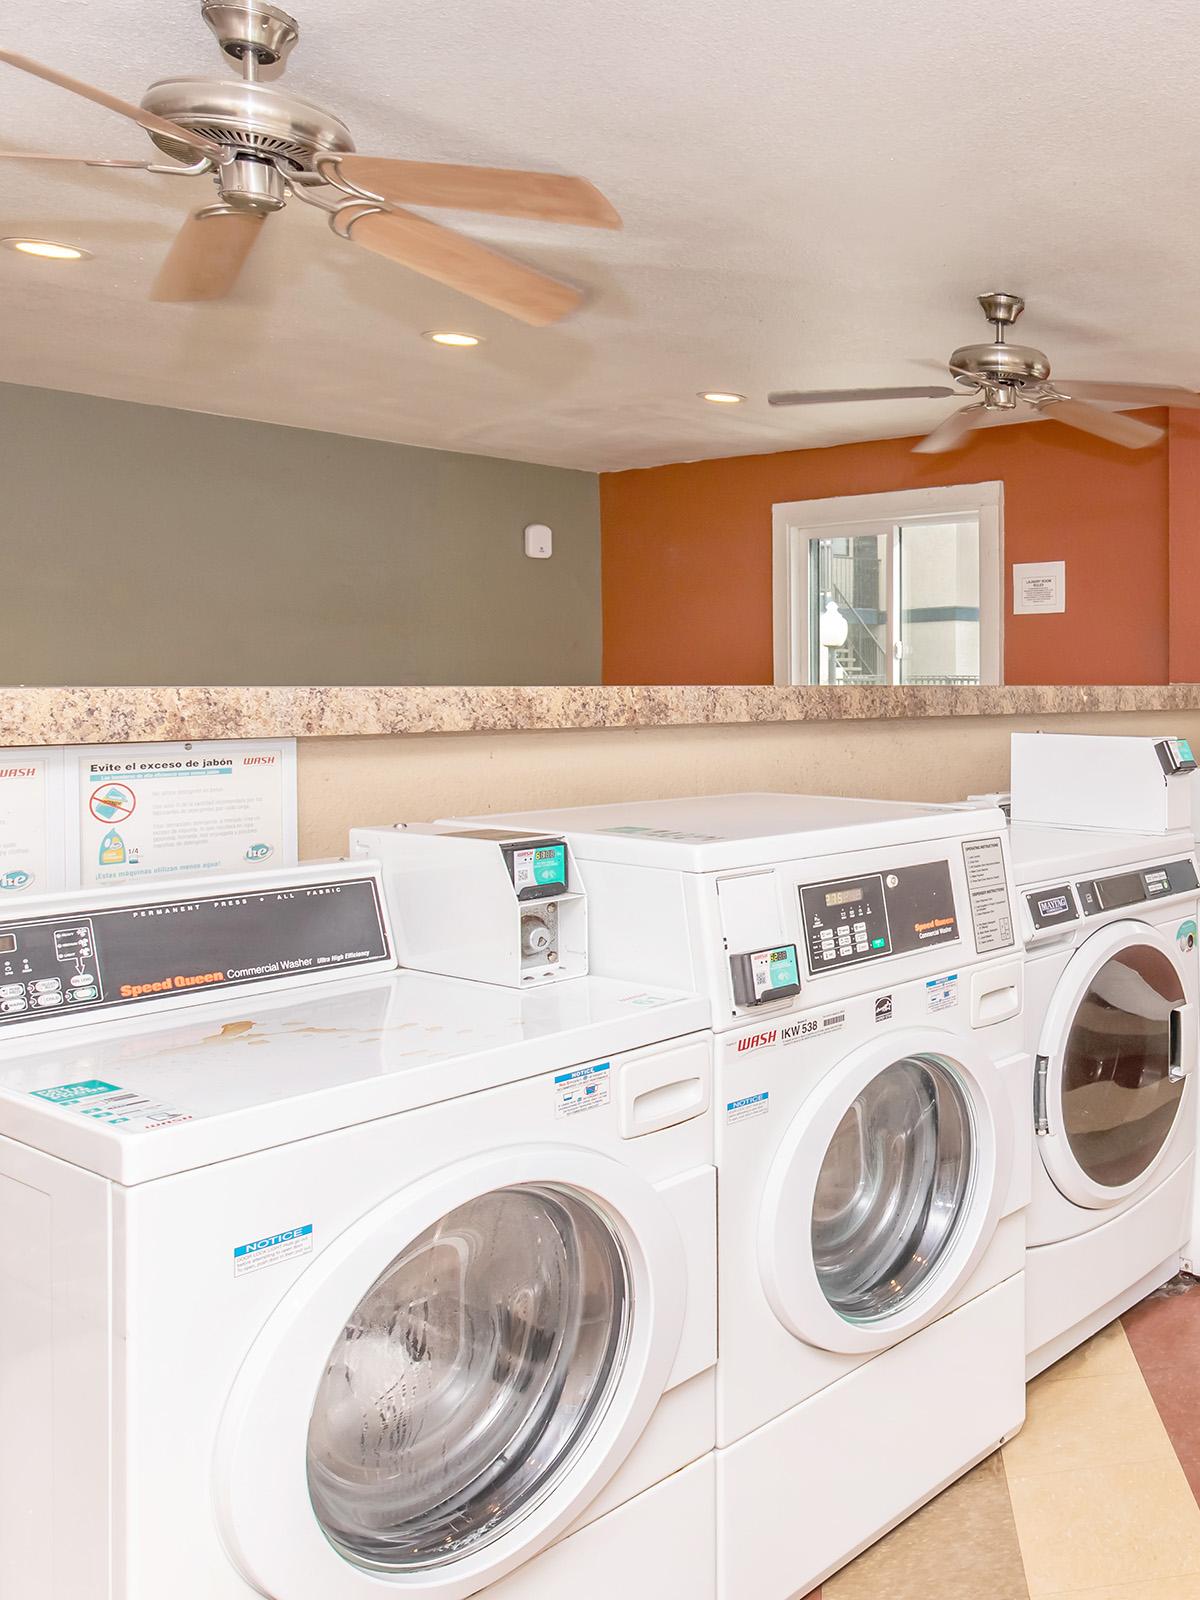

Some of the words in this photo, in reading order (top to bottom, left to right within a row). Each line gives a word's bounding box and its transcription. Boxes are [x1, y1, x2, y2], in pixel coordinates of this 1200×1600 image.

[90, 763, 121, 773] Evite
[125, 762, 136, 771] el
[139, 760, 182, 770] exceso
[185, 759, 199, 769] de
[202, 758, 233, 769] jabón
[243, 756, 275, 766] WASH
[132, 904, 201, 918] PERMANENT
[213, 898, 249, 908] PRESS
[276, 892, 296, 901] ALL
[306, 886, 342, 897] FABRIC
[1041, 898, 1066, 910] MAYTAG
[914, 919, 935, 932] Speed
[934, 917, 954, 927] Queen
[120, 974, 173, 998] Speed
[174, 970, 225, 988] Queen
[226, 961, 280, 980] Commercial
[280, 956, 313, 970] Washer
[316, 956, 330, 965] Ultra
[331, 954, 344, 964] High
[344, 950, 370, 961] Efficiency
[737, 1029, 777, 1052] WASH
[781, 1025, 801, 1040] IKW
[801, 1020, 818, 1034] 538
[571, 1067, 594, 1079] NOTICE
[733, 1094, 762, 1108] NOTICE
[245, 1227, 303, 1253] NOTICE
